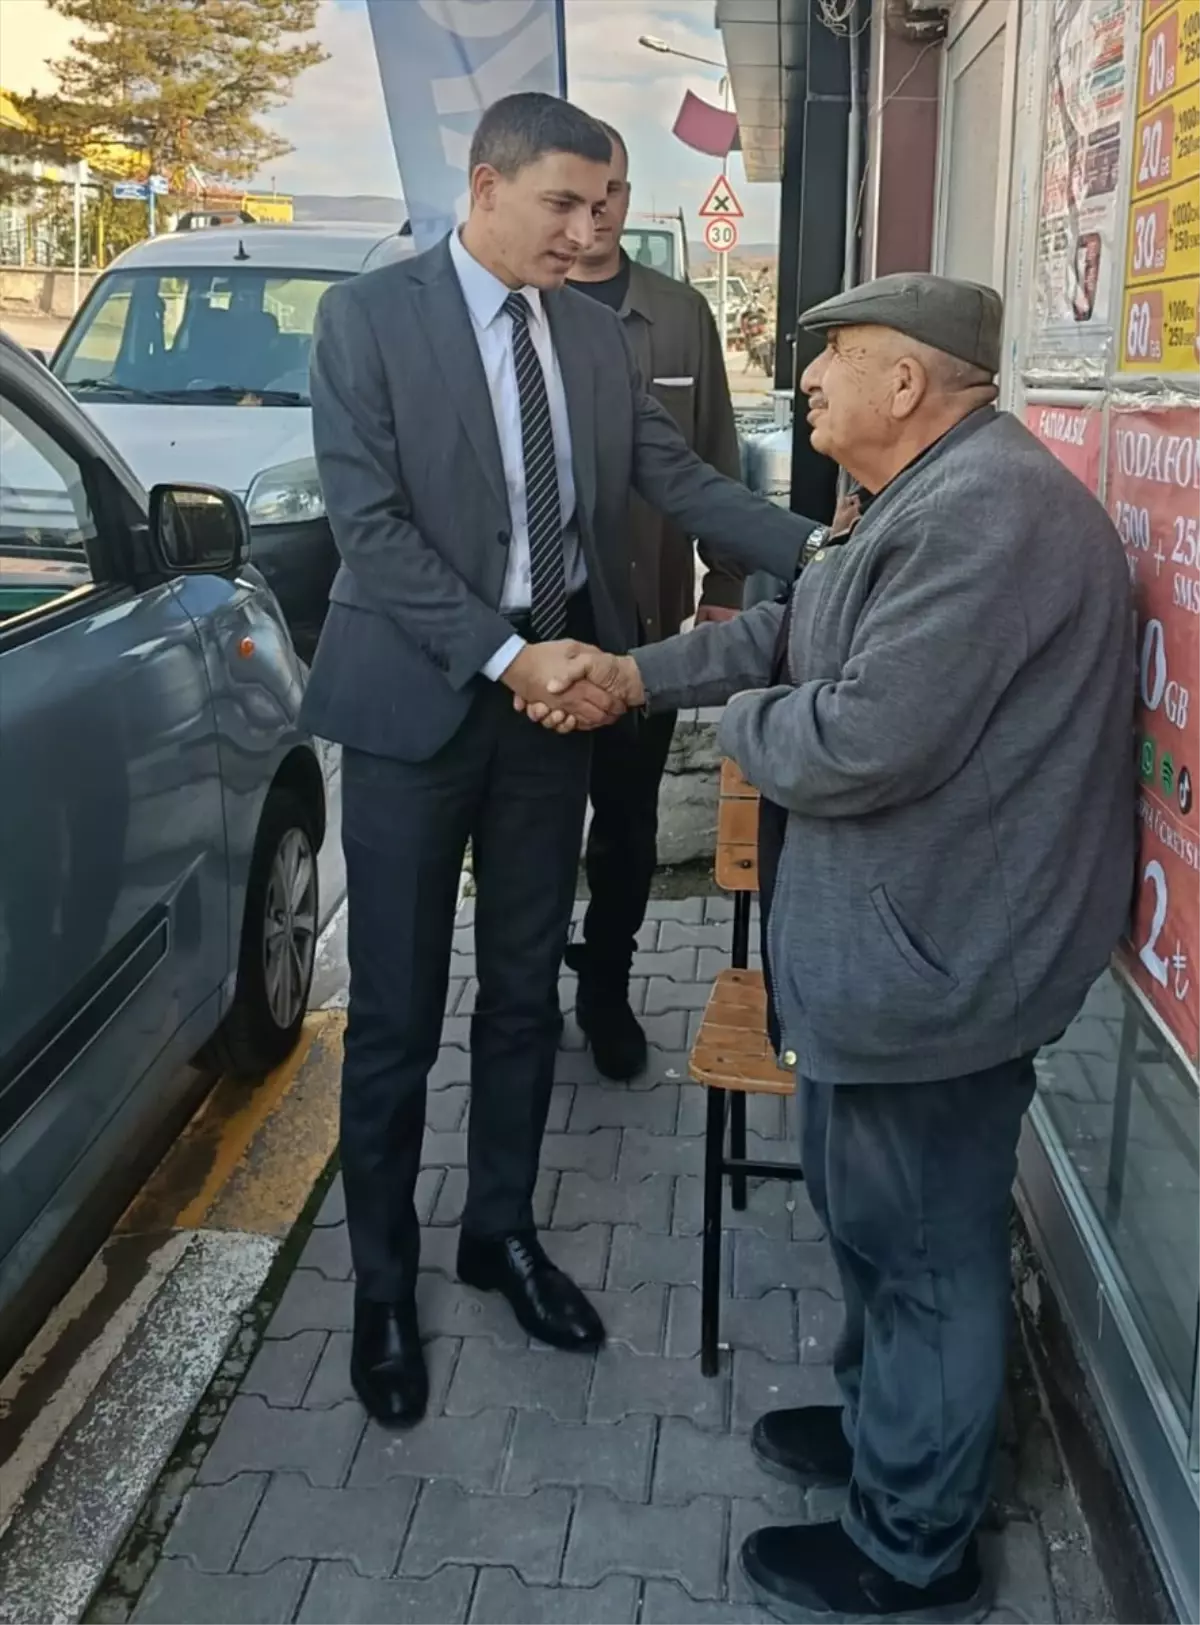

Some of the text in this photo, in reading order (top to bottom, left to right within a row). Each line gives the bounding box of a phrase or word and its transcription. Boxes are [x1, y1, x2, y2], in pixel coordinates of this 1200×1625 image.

[1148, 32, 1166, 96] 10
[1139, 120, 1161, 182] 20
[711, 226, 732, 243] 30
[1134, 212, 1156, 270] 30
[1128, 301, 1150, 357] 60
[1164, 680, 1189, 729] GB
[1139, 859, 1168, 988] 2
